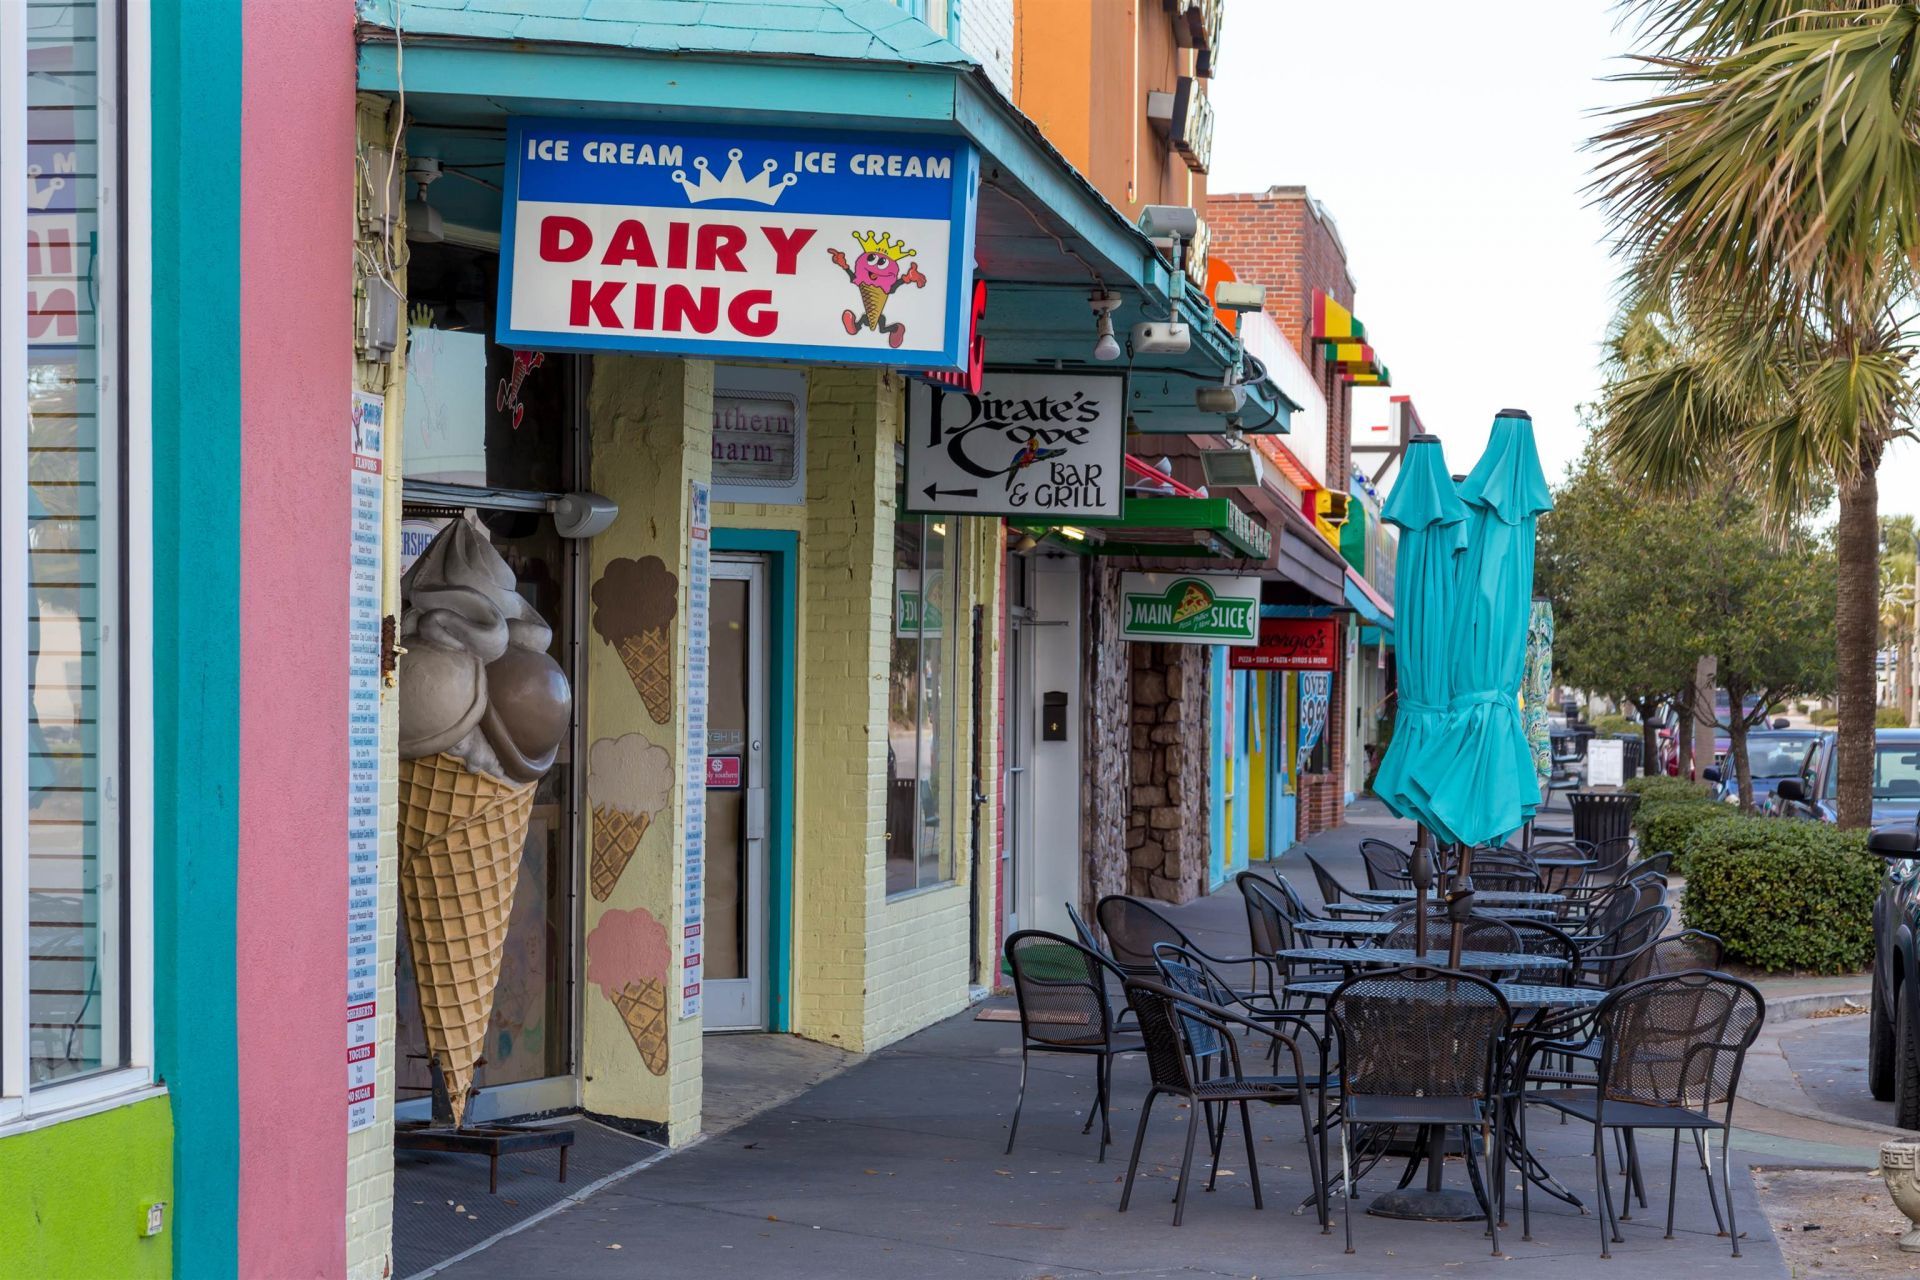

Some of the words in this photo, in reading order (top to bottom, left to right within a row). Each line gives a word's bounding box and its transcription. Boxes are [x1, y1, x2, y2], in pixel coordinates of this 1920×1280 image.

[527, 139, 569, 163] ICE
[582, 141, 683, 167] CREAM
[794, 151, 837, 174] ICE
[849, 154, 951, 179] CREAM
[539, 215, 818, 276] DAIRY
[568, 279, 780, 338] KING
[947, 420, 1090, 479] Cove
[1009, 483, 1029, 507] &
[1034, 484, 1107, 509] GRILL
[1134, 603, 1172, 625] MAIN
[1210, 606, 1245, 629] SLICE
[1273, 656, 1288, 664] PASTA
[1304, 676, 1328, 696] OVER
